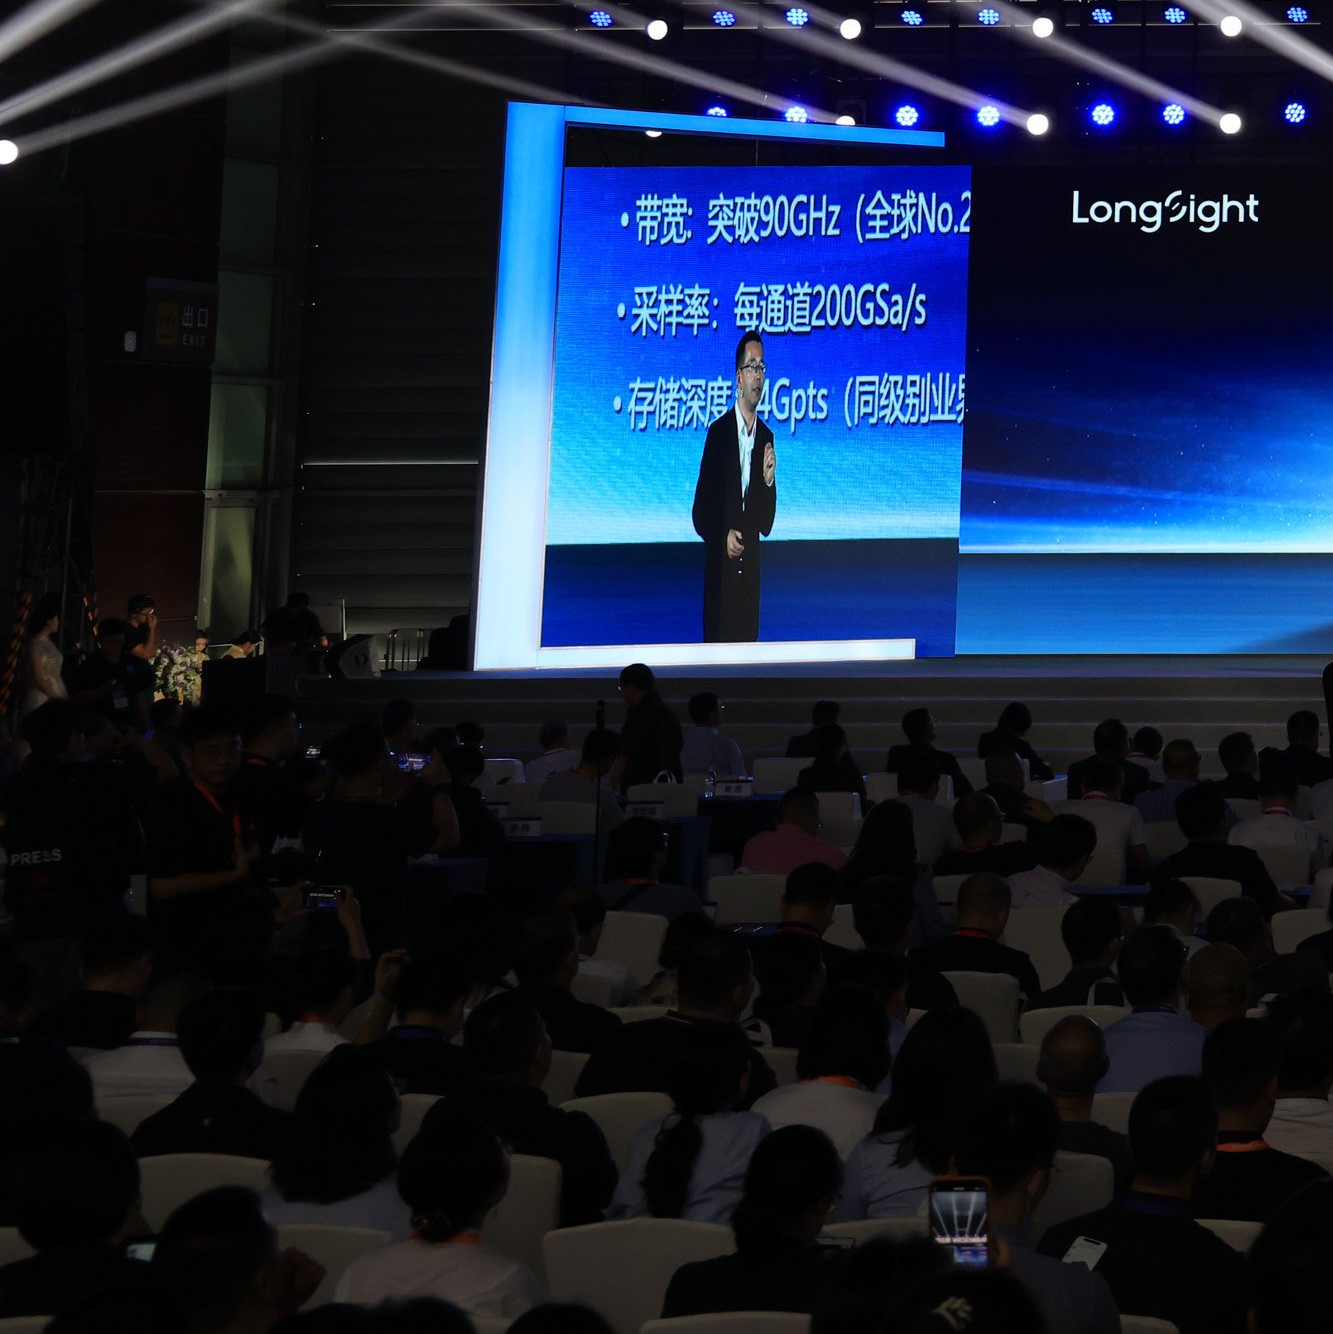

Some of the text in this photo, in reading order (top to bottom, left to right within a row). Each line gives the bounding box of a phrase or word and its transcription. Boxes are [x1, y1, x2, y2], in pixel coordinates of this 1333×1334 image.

[1072, 190, 1259, 233] LongSight
[183, 305, 209, 329] 出口
[183, 333, 208, 347] EXIT
[10, 848, 64, 867] PRESS
